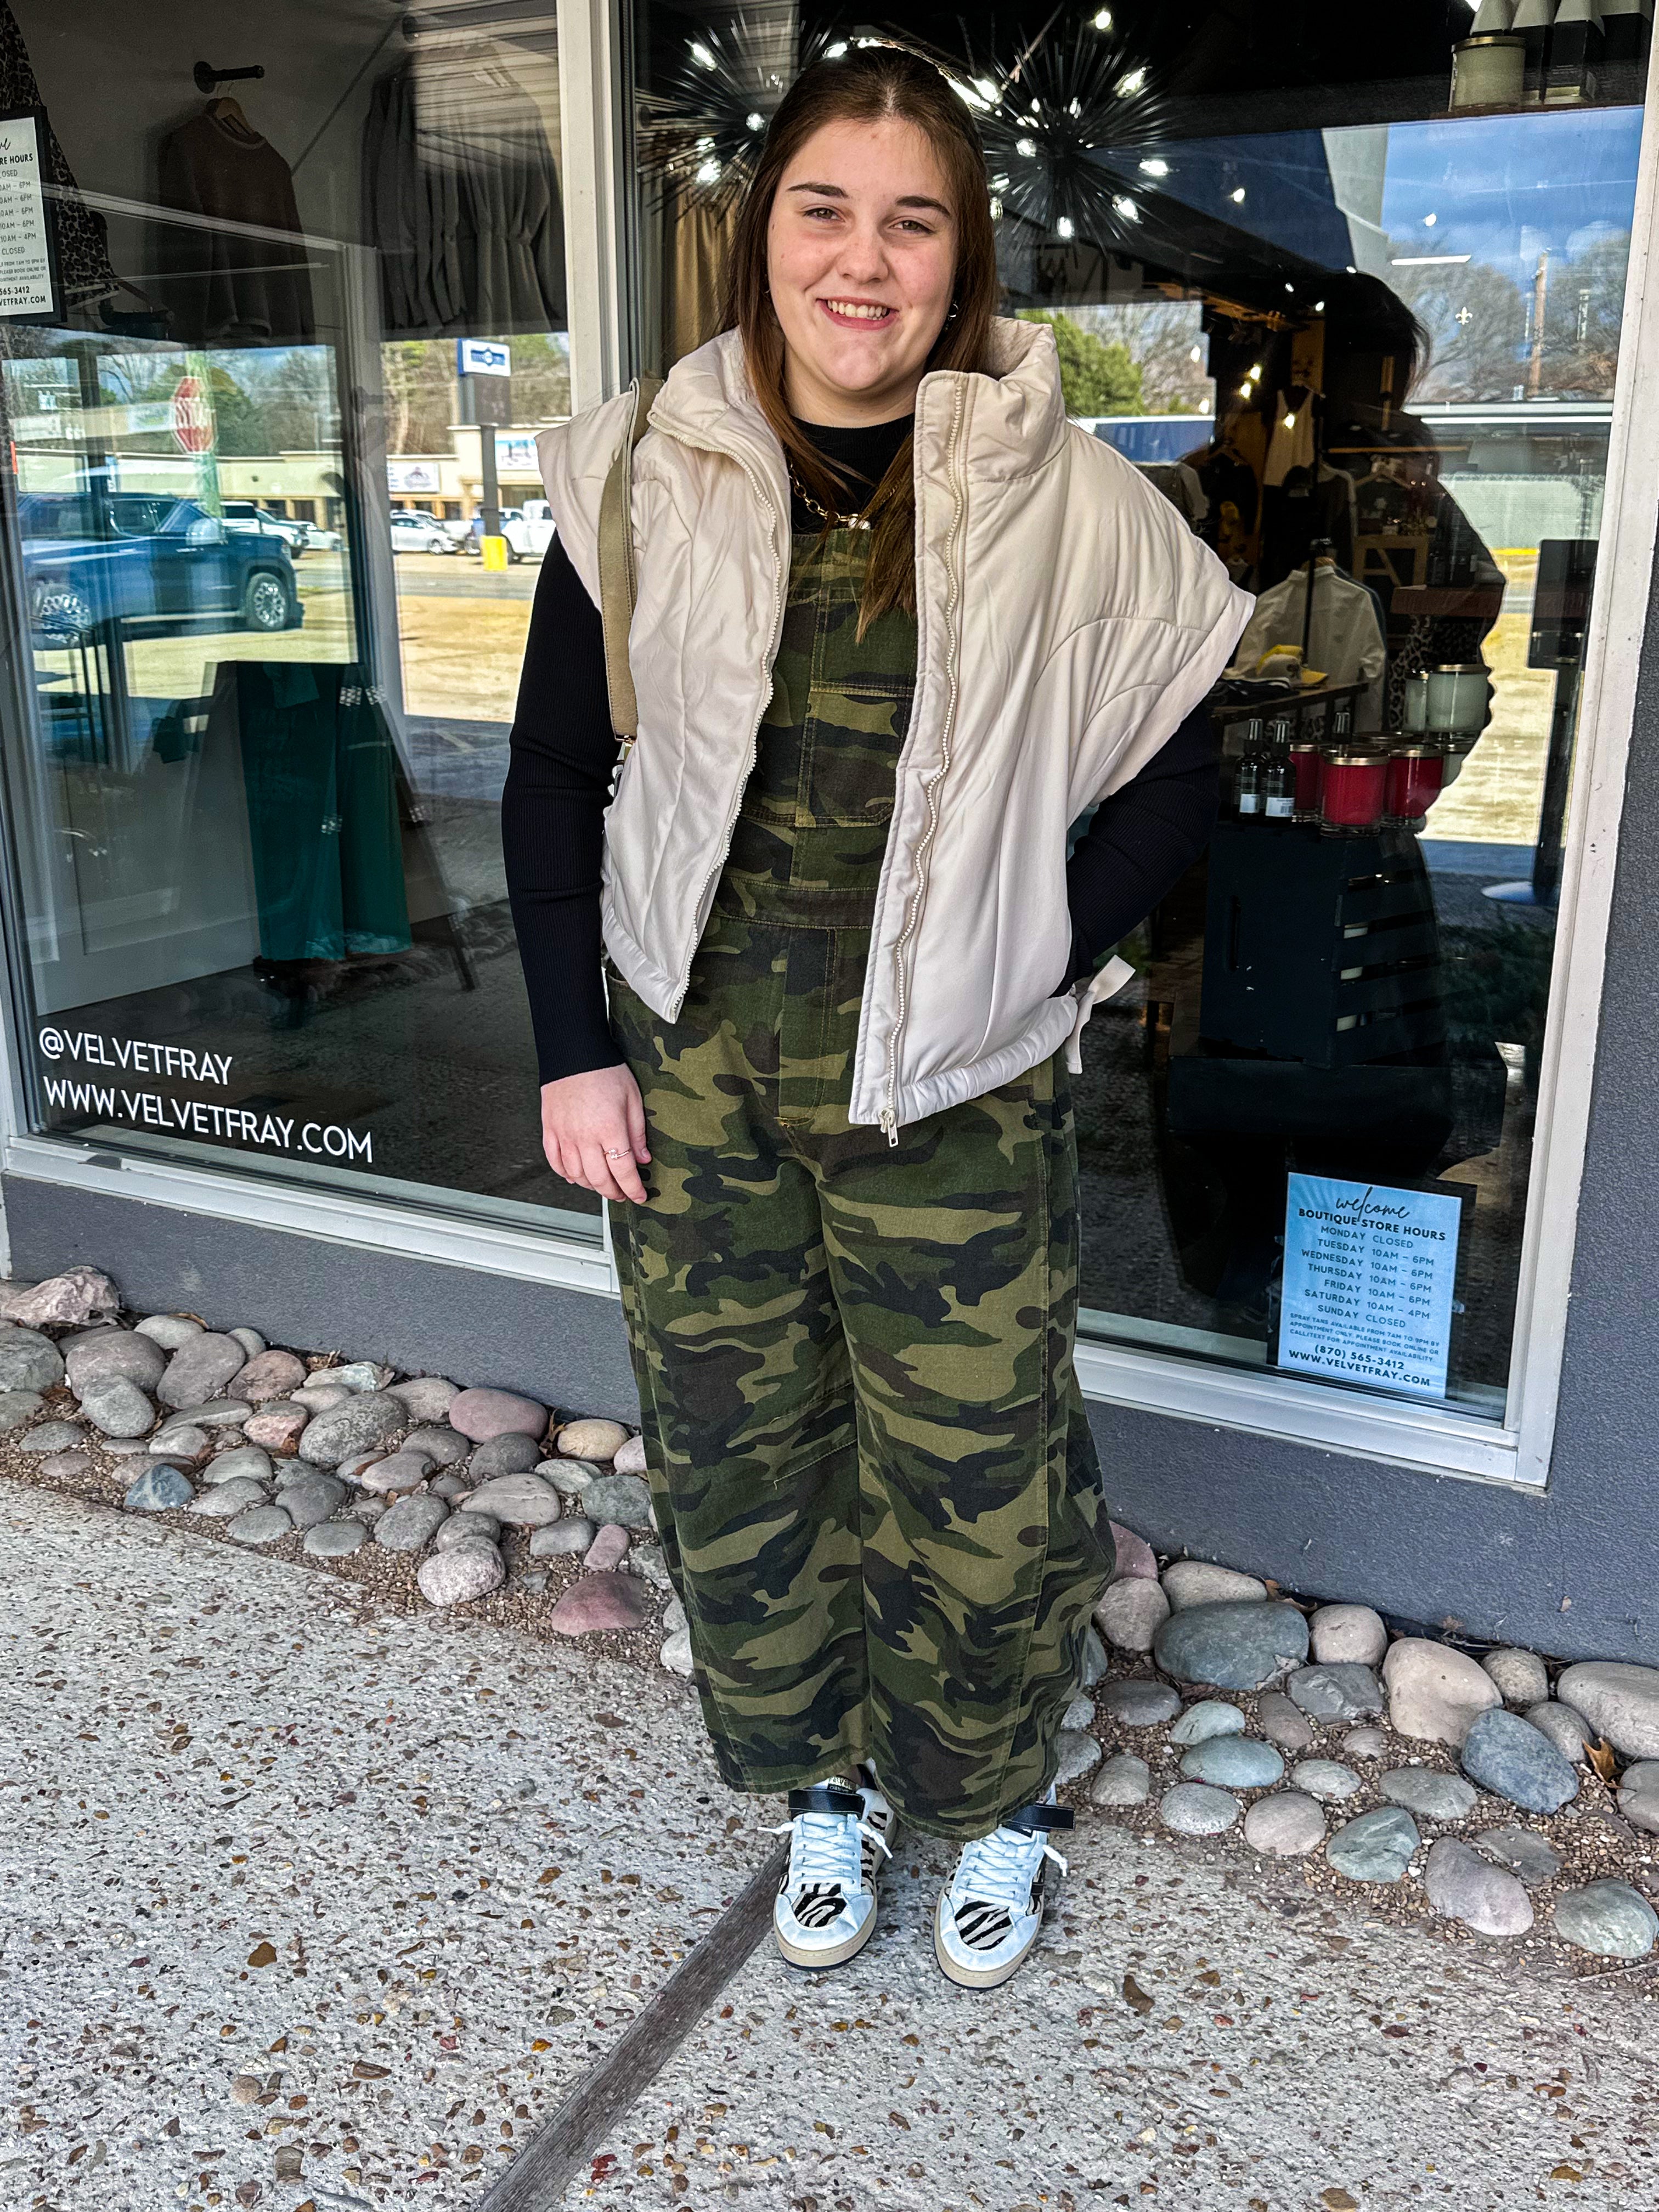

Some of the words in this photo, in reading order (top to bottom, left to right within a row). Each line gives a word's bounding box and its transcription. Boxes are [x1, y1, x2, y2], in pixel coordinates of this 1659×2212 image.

[9, 153, 33, 164] HOURS
[20, 194, 32, 202] 6PM
[21, 206, 33, 215] 6PM
[1, 234, 16, 242] 10AM
[2, 246, 25, 255] CLOSED
[39, 1026, 233, 1086] @VELVETFRAY
[43, 1075, 373, 1164] WWW.VELVETFRAY.COM
[1335, 1186, 1410, 1222] welcome
[1298, 1208, 1357, 1226] BOUTIQUE
[1361, 1218, 1400, 1233] STORE
[1403, 1226, 1446, 1242] HOURS
[1321, 1225, 1365, 1240] MONDAY
[1372, 1235, 1413, 1249] CLOSED
[1301, 1249, 1363, 1267] WEDNESDAY
[1370, 1261, 1397, 1273] 10AM
[1411, 1268, 1433, 1279] 6PM
[1317, 1238, 1365, 1254] TUESDAY
[1372, 1248, 1398, 1260] 10AM
[1412, 1255, 1434, 1266] 6PM
[1308, 1263, 1362, 1280] THURSDAY
[1369, 1274, 1396, 1286] 10AM
[1409, 1282, 1431, 1293] 6PM
[1304, 1289, 1361, 1306] SATURDAY
[1367, 1301, 1394, 1313] 10AM
[1408, 1308, 1430, 1319] 4PM
[1324, 1279, 1361, 1294] FRIDAY
[1368, 1288, 1395, 1300] 10AM
[1408, 1295, 1430, 1306] 6PM
[1290, 1313, 1311, 1321] SPRAY
[1330, 1321, 1365, 1333] AVAILABLE
[1367, 1328, 1385, 1336] FROM
[1317, 1304, 1359, 1319] SUNDAY
[1365, 1314, 1406, 1328] CLOSED
[1290, 1321, 1333, 1333] APPOINTMENT
[1356, 1334, 1380, 1344] PLEASE
[1382, 1339, 1401, 1347] BOOK
[1403, 1344, 1427, 1353] ONLINE
[1290, 1329, 1325, 1340] CALL/TEXT
[1342, 1339, 1387, 1352] APPOINTMENT
[1289, 1350, 1430, 1386] WWW.VELVETFRAY.COM
[1314, 1344, 1346, 1359] (870)
[1350, 1351, 1404, 1370] 565-3412
